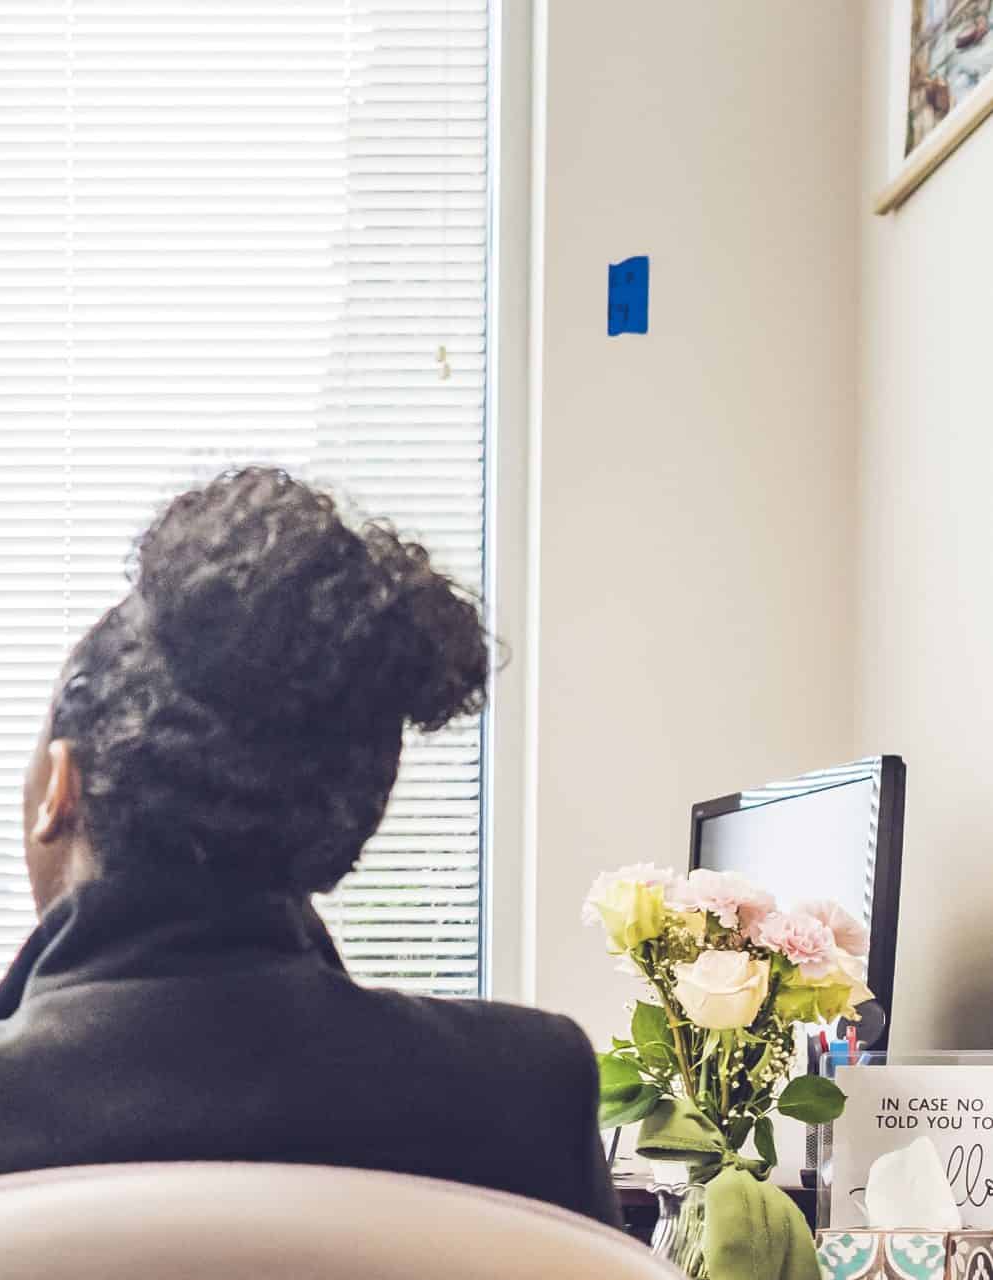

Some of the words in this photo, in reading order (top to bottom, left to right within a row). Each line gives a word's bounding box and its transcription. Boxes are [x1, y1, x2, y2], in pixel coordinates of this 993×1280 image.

[881, 1097, 900, 1111] IN
[908, 1097, 949, 1111] CASE
[957, 1098, 985, 1112] NO
[875, 1115, 919, 1129] TOLD
[927, 1116, 963, 1129] YOU
